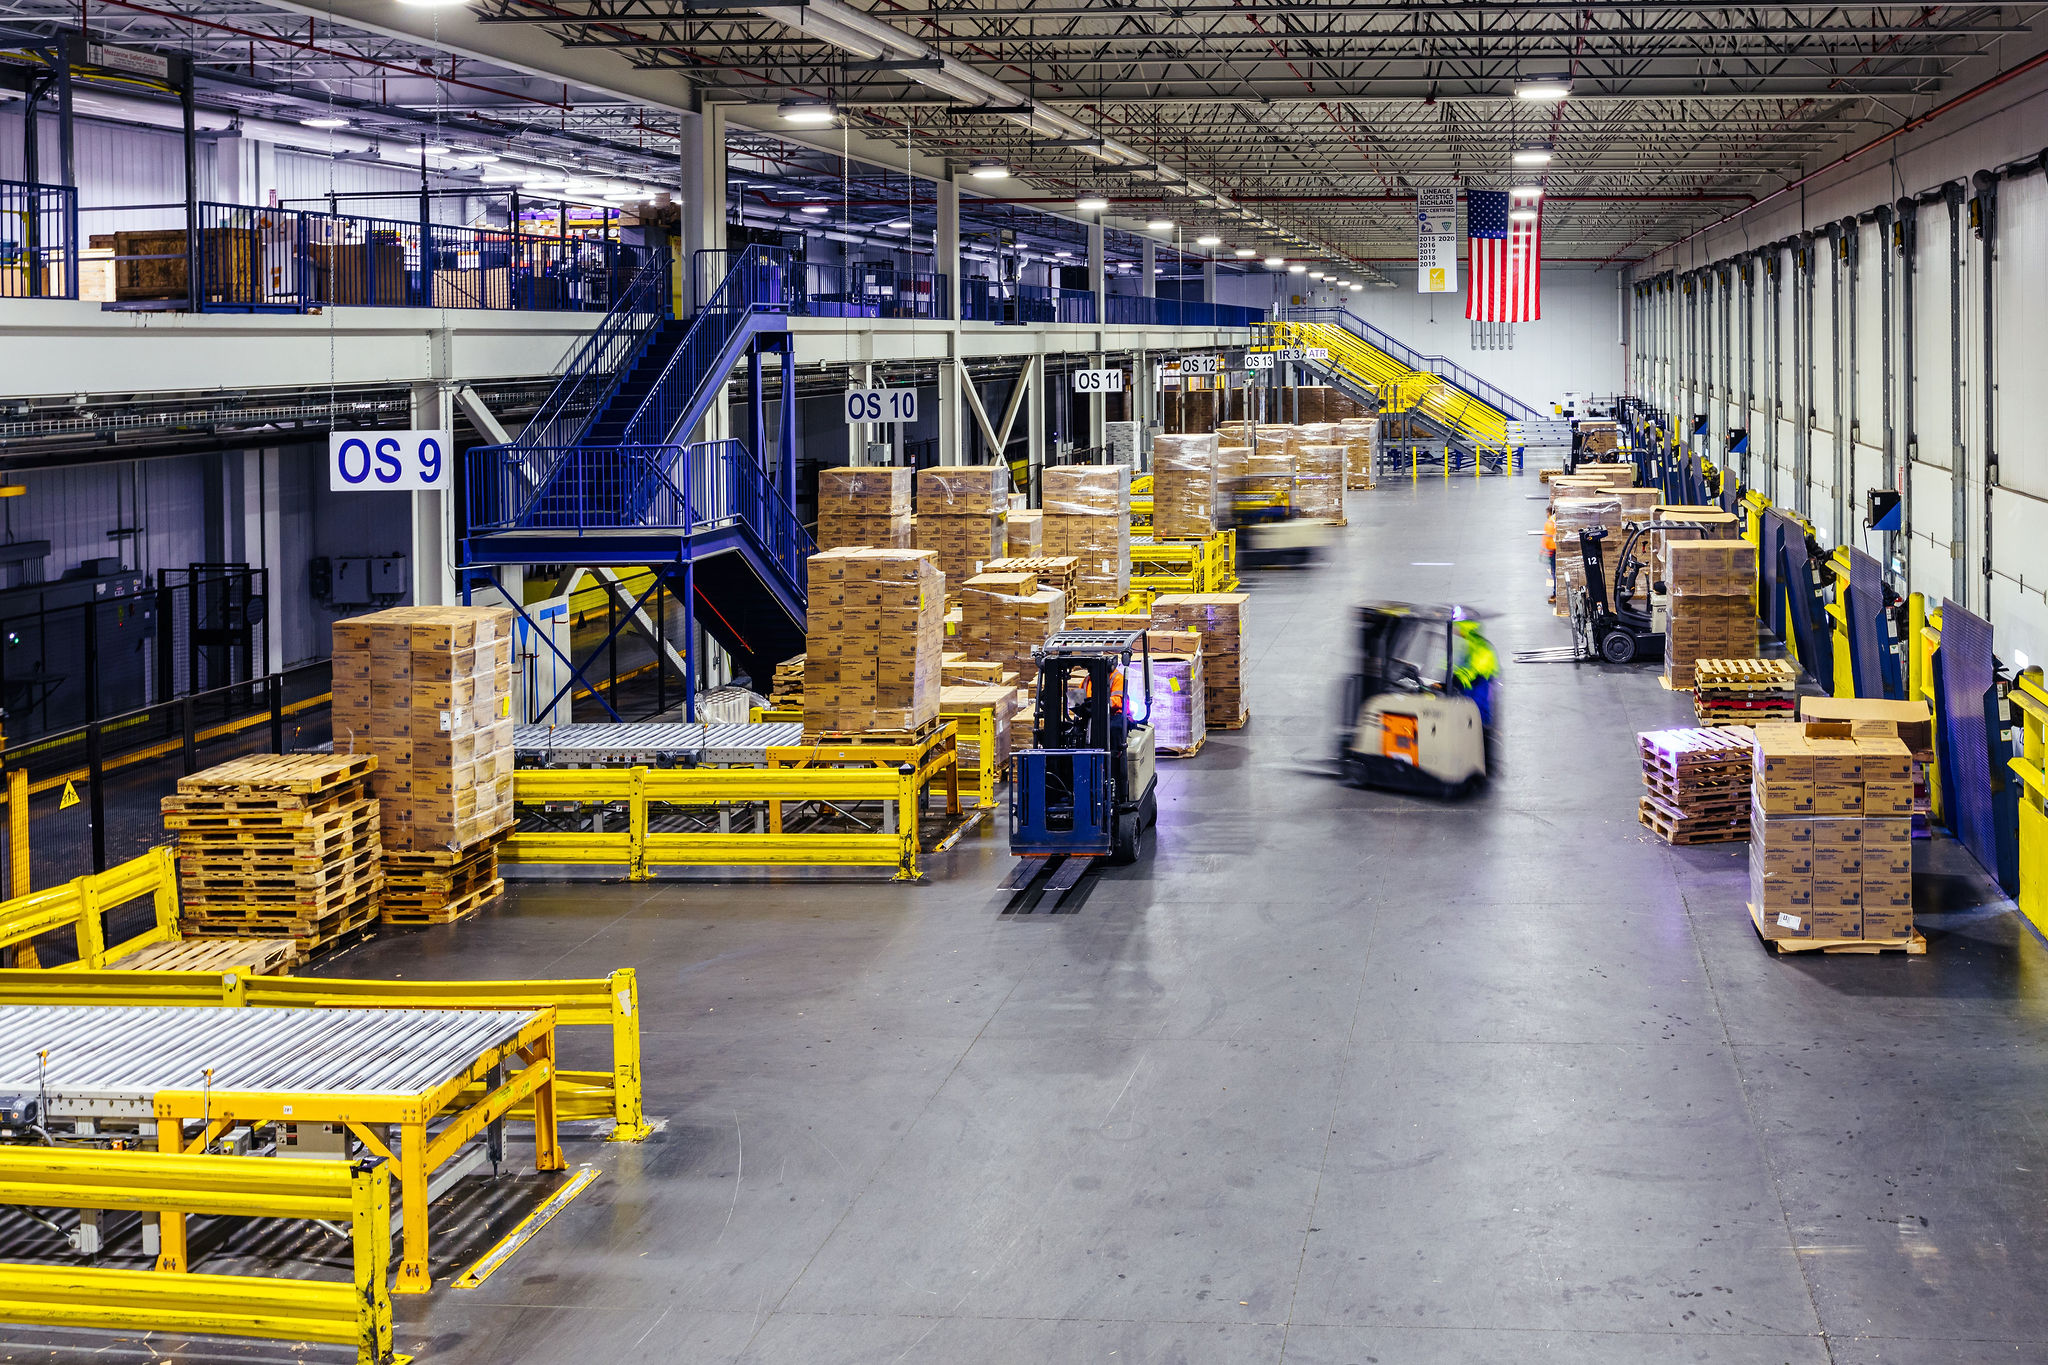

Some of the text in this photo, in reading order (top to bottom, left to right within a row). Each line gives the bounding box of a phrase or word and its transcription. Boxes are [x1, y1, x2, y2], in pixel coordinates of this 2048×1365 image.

[1280, 349, 1300, 360] IR 3
[1308, 349, 1326, 358] ATR
[1182, 359, 1216, 372] OS 12
[1246, 356, 1273, 367] OS 13
[1079, 372, 1119, 389] OS 11
[848, 392, 914, 420] OS 10
[338, 437, 442, 484] OS 9
[1587, 556, 1597, 565] 12
